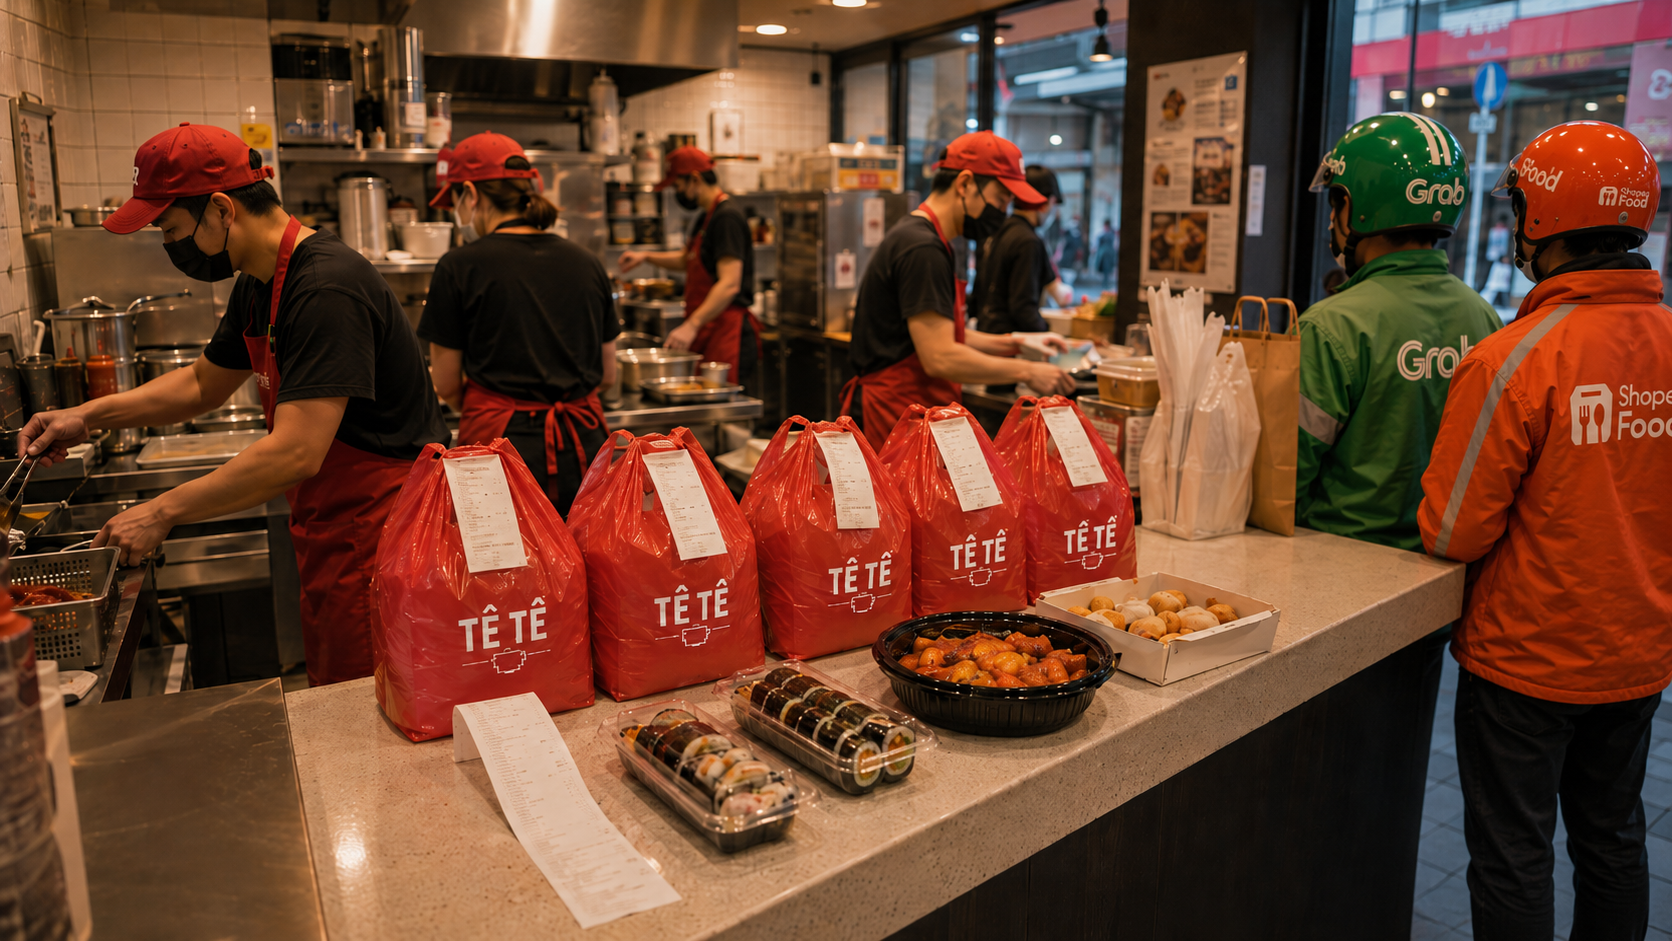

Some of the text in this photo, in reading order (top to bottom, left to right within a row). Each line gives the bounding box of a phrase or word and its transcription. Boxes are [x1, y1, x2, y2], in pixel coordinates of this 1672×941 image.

[1406, 177, 1465, 206] Grab
[1618, 195, 1648, 208] Food
[654, 578, 729, 627] TÊ TÊ
[458, 603, 500, 652] TÊ
